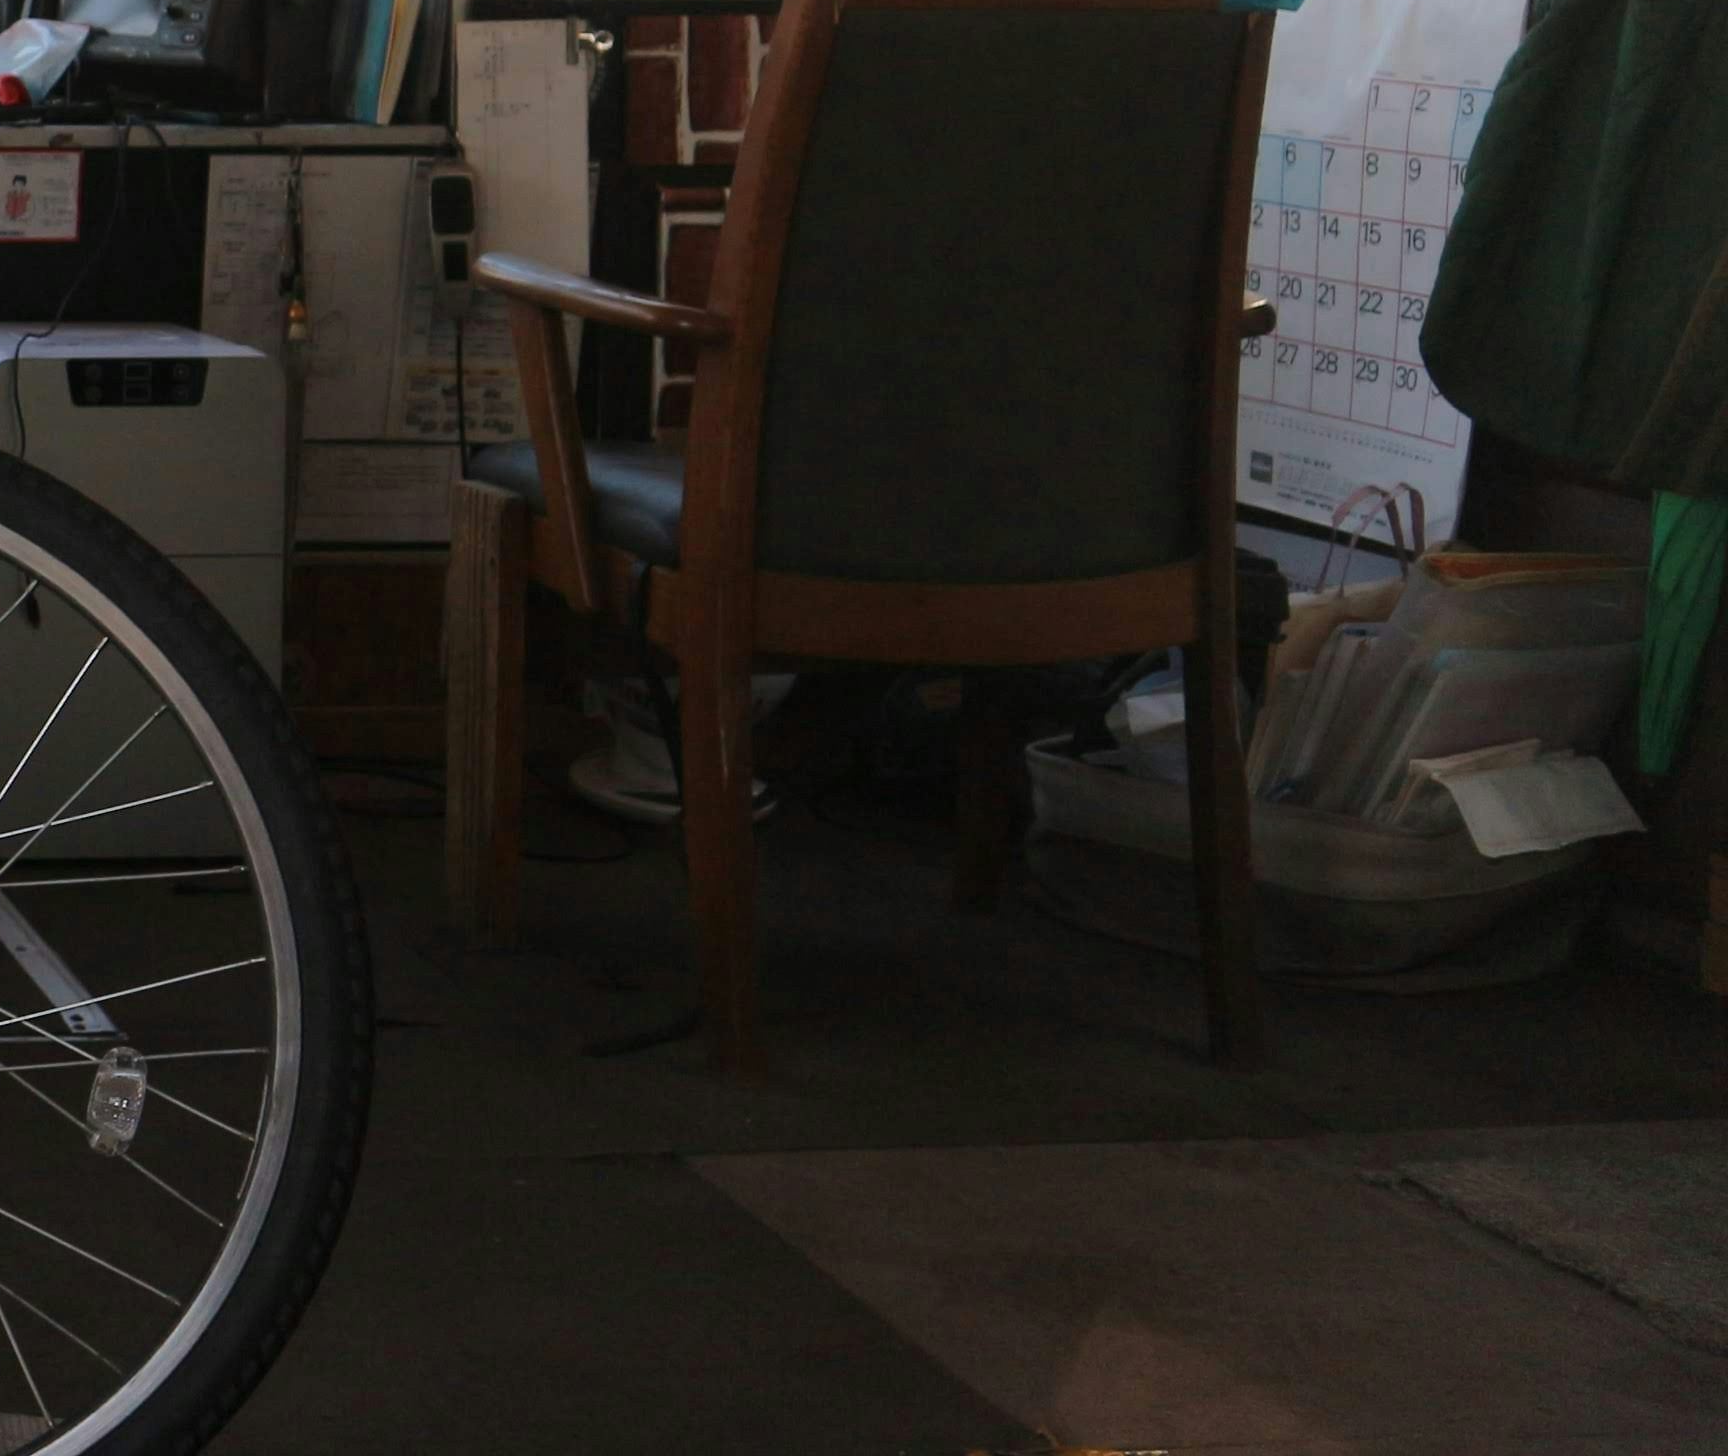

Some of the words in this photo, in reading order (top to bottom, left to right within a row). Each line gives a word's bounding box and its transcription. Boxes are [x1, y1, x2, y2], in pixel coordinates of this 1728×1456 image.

[1373, 85, 1380, 108] 1
[1415, 90, 1430, 111] 2
[1462, 94, 1474, 116] 3
[1286, 143, 1296, 164] 6
[1325, 148, 1335, 171] 7
[1366, 153, 1379, 175] 8
[1408, 159, 1421, 181] 9
[1283, 210, 1300, 233] 13
[1321, 216, 1339, 239] 14
[1363, 222, 1381, 245] 15
[1405, 229, 1425, 252] 16
[1280, 275, 1302, 299] 20
[1318, 283, 1336, 305] 21
[1359, 290, 1383, 314] 22
[1401, 296, 1424, 321] 23
[1240, 337, 1261, 358] 26
[1277, 342, 1298, 365] 27
[1315, 351, 1338, 374] 28
[1356, 359, 1379, 382] 29
[1395, 366, 1417, 390] 30
